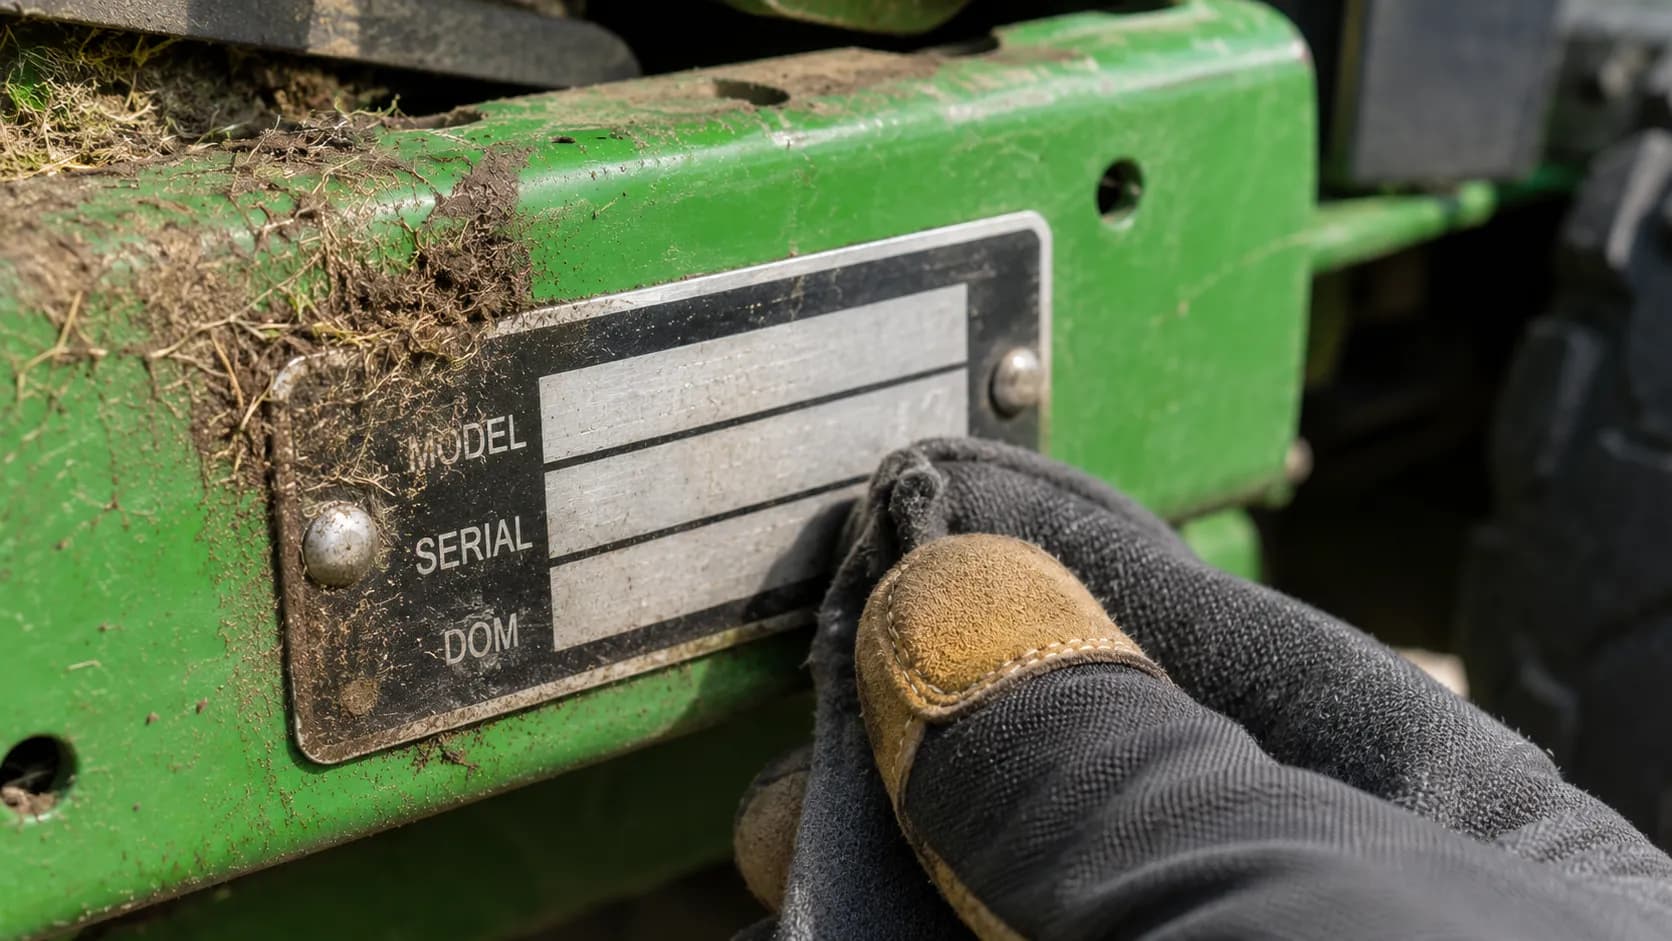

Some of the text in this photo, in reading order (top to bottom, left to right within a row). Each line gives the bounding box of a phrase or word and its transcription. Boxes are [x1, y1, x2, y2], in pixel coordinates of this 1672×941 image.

[408, 414, 527, 471] MODEL
[415, 515, 533, 575] SERIAL
[444, 613, 519, 665] DOM
